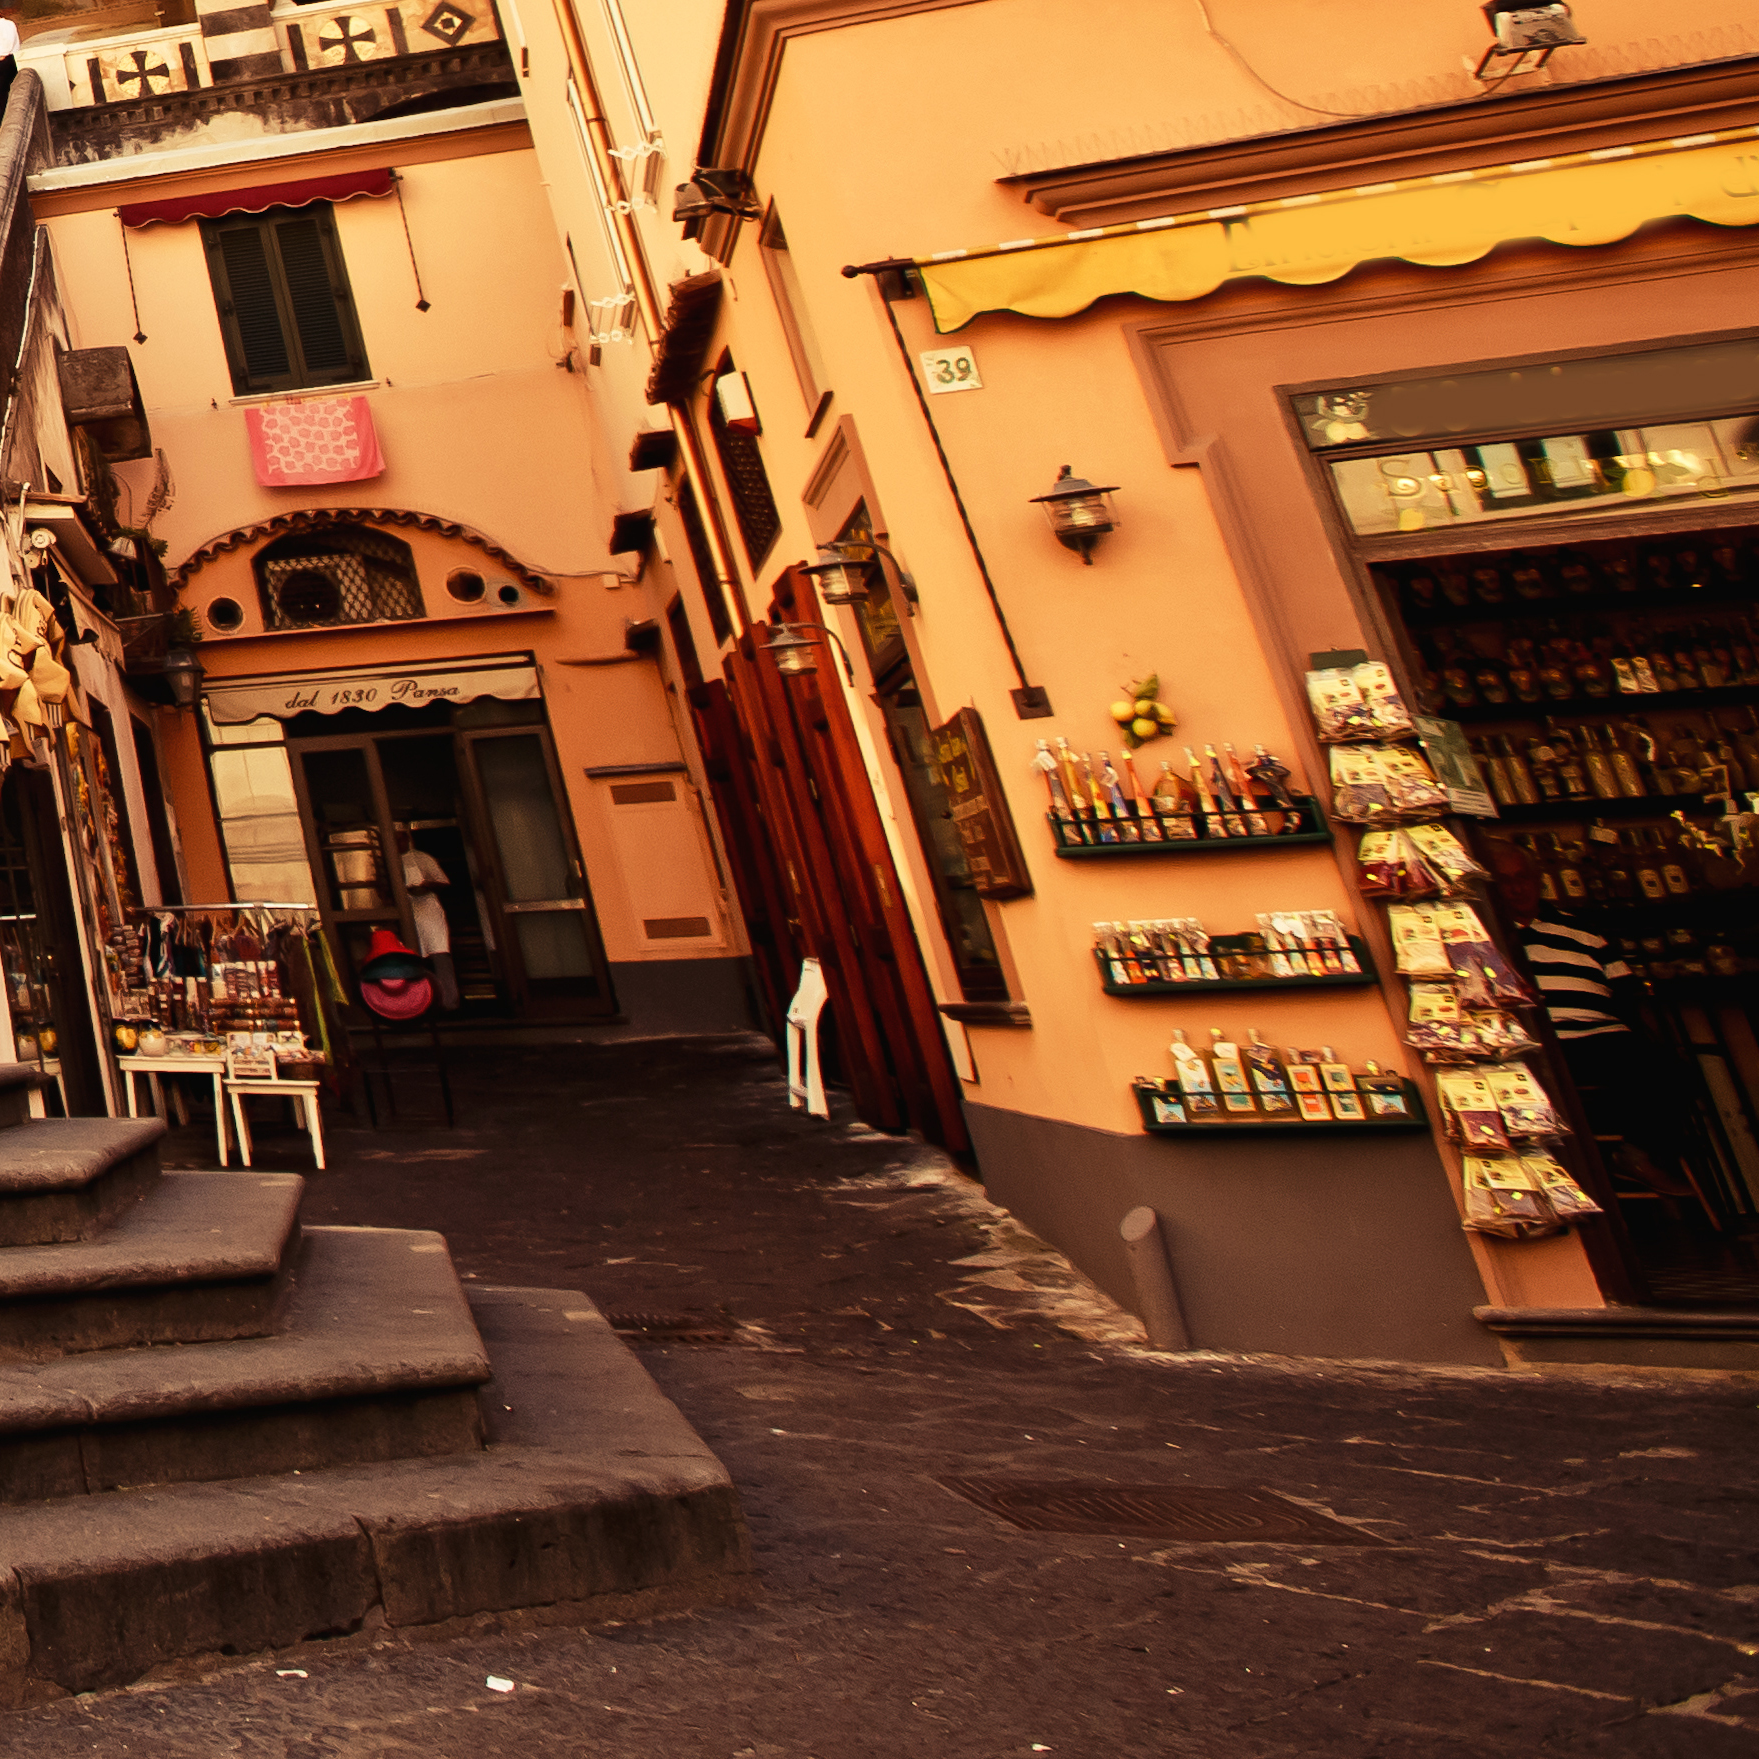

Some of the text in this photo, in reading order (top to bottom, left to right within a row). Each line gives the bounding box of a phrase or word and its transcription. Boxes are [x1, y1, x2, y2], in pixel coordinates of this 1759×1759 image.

[936, 356, 973, 384] 39
[285, 679, 460, 709] dal 1830 Pansa
